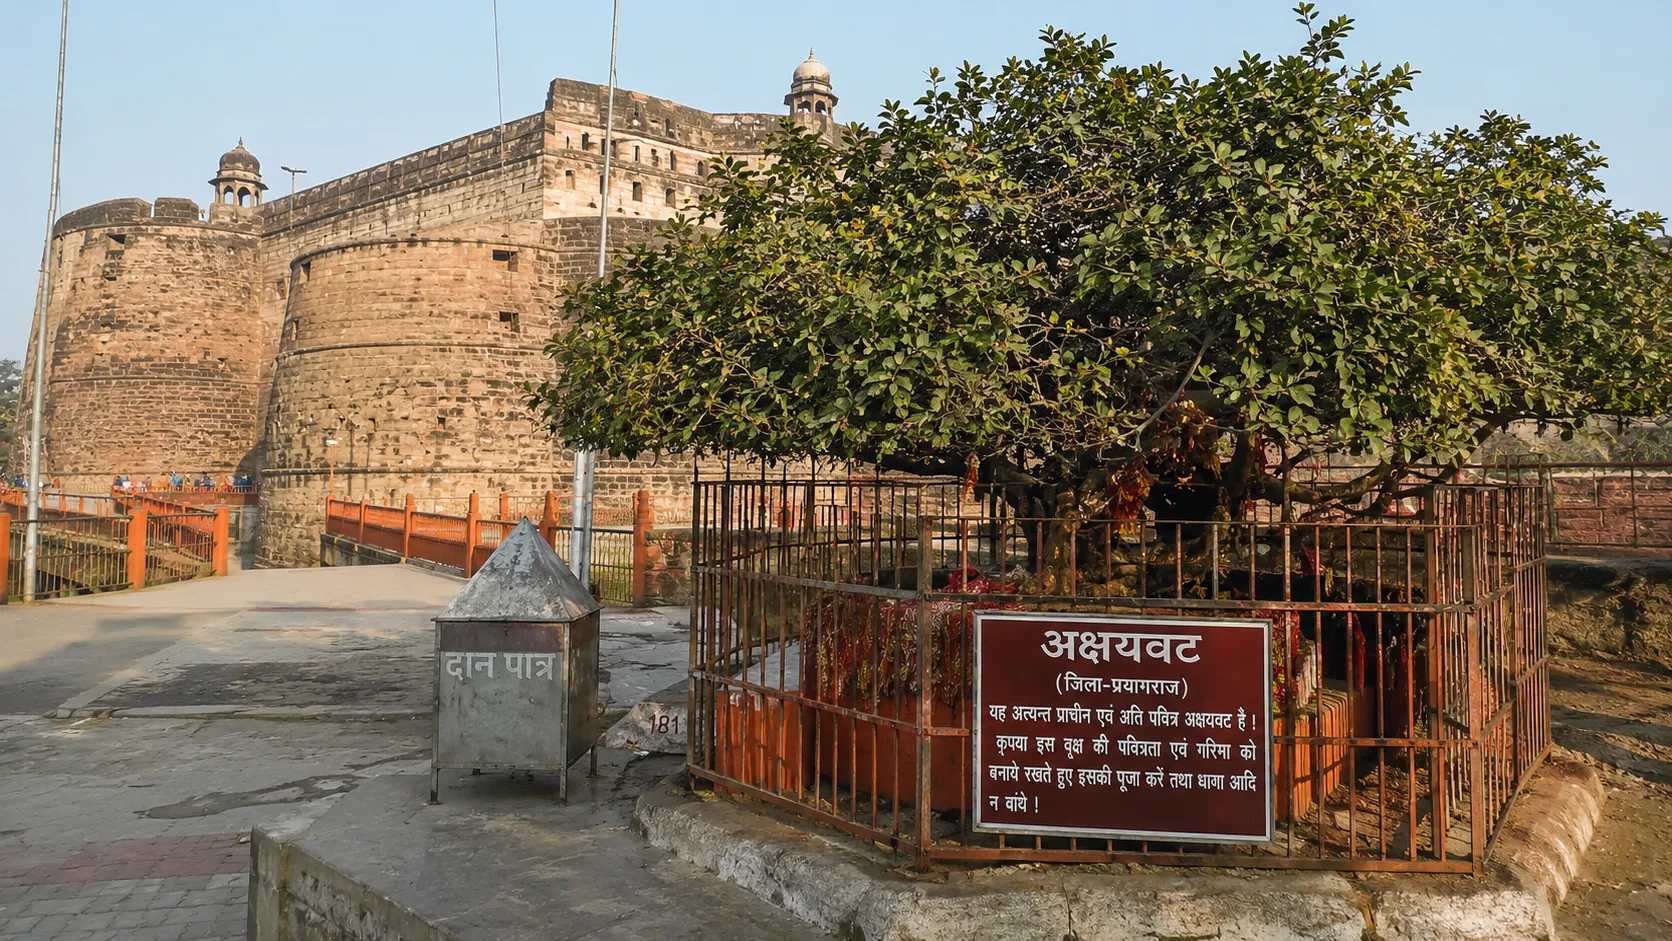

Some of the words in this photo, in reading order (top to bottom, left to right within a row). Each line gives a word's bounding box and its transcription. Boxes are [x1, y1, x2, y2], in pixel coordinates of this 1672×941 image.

[1041, 630, 1202, 665] अक्षयवट
[446, 652, 497, 681] दान
[503, 652, 556, 680] पात्र
[649, 714, 679, 735] 181
[988, 704, 1007, 722] यह
[1012, 705, 1051, 722] अत्यन्त
[1096, 704, 1115, 727] एवं
[1119, 704, 1143, 726] अति
[1148, 705, 1179, 727] पवित्र
[996, 735, 1028, 756] कृपया
[1036, 737, 1055, 755] इस
[1092, 733, 1109, 755] की
[1117, 734, 1162, 757] पवित्रता
[1169, 737, 1188, 760] एवं
[1196, 737, 1231, 760] गरिमा
[1240, 738, 1257, 760] को
[989, 760, 1019, 782] बनाये
[1024, 762, 1052, 783] रखते
[1057, 768, 1073, 789] हुए
[1078, 764, 1112, 787] इसकी
[1116, 770, 1141, 793] पूजा
[1145, 766, 1164, 788] करें
[1169, 773, 1193, 789] तथा
[1229, 769, 1257, 792] आदि
[989, 795, 999, 811] न
